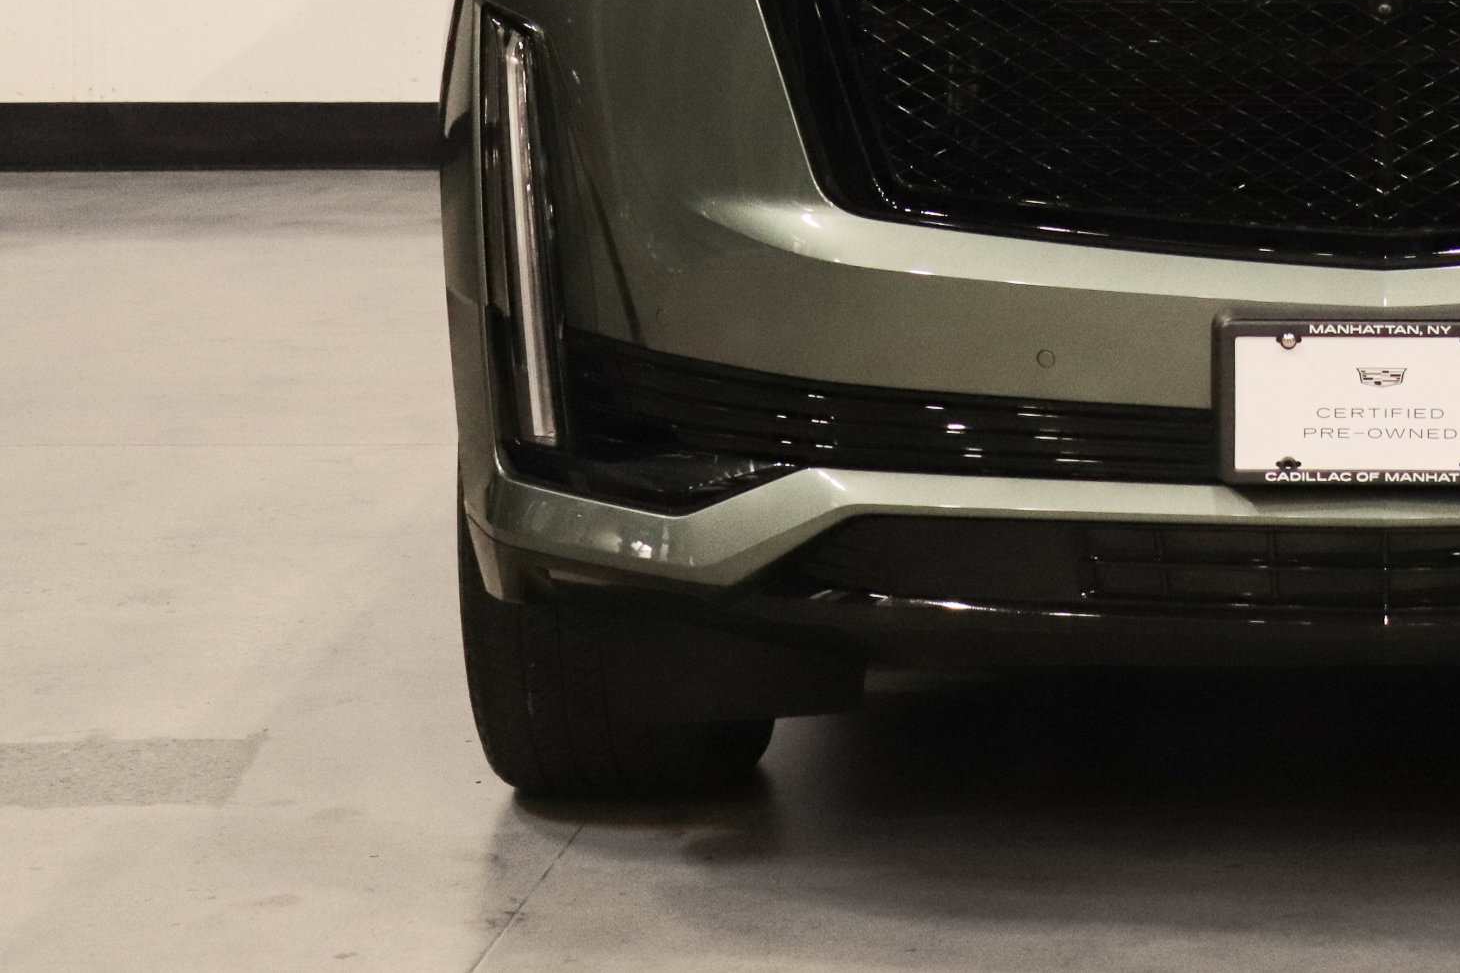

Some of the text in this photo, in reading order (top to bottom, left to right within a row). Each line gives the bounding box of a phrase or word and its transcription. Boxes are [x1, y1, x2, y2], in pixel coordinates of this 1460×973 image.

[1308, 324, 1452, 336] MANHATTAN, NY
[1316, 407, 1445, 420] CERTIFIED
[1303, 427, 1459, 440] PRE-OWNED
[1264, 471, 1352, 483] CADILLAC
[1355, 472, 1380, 483] OF
